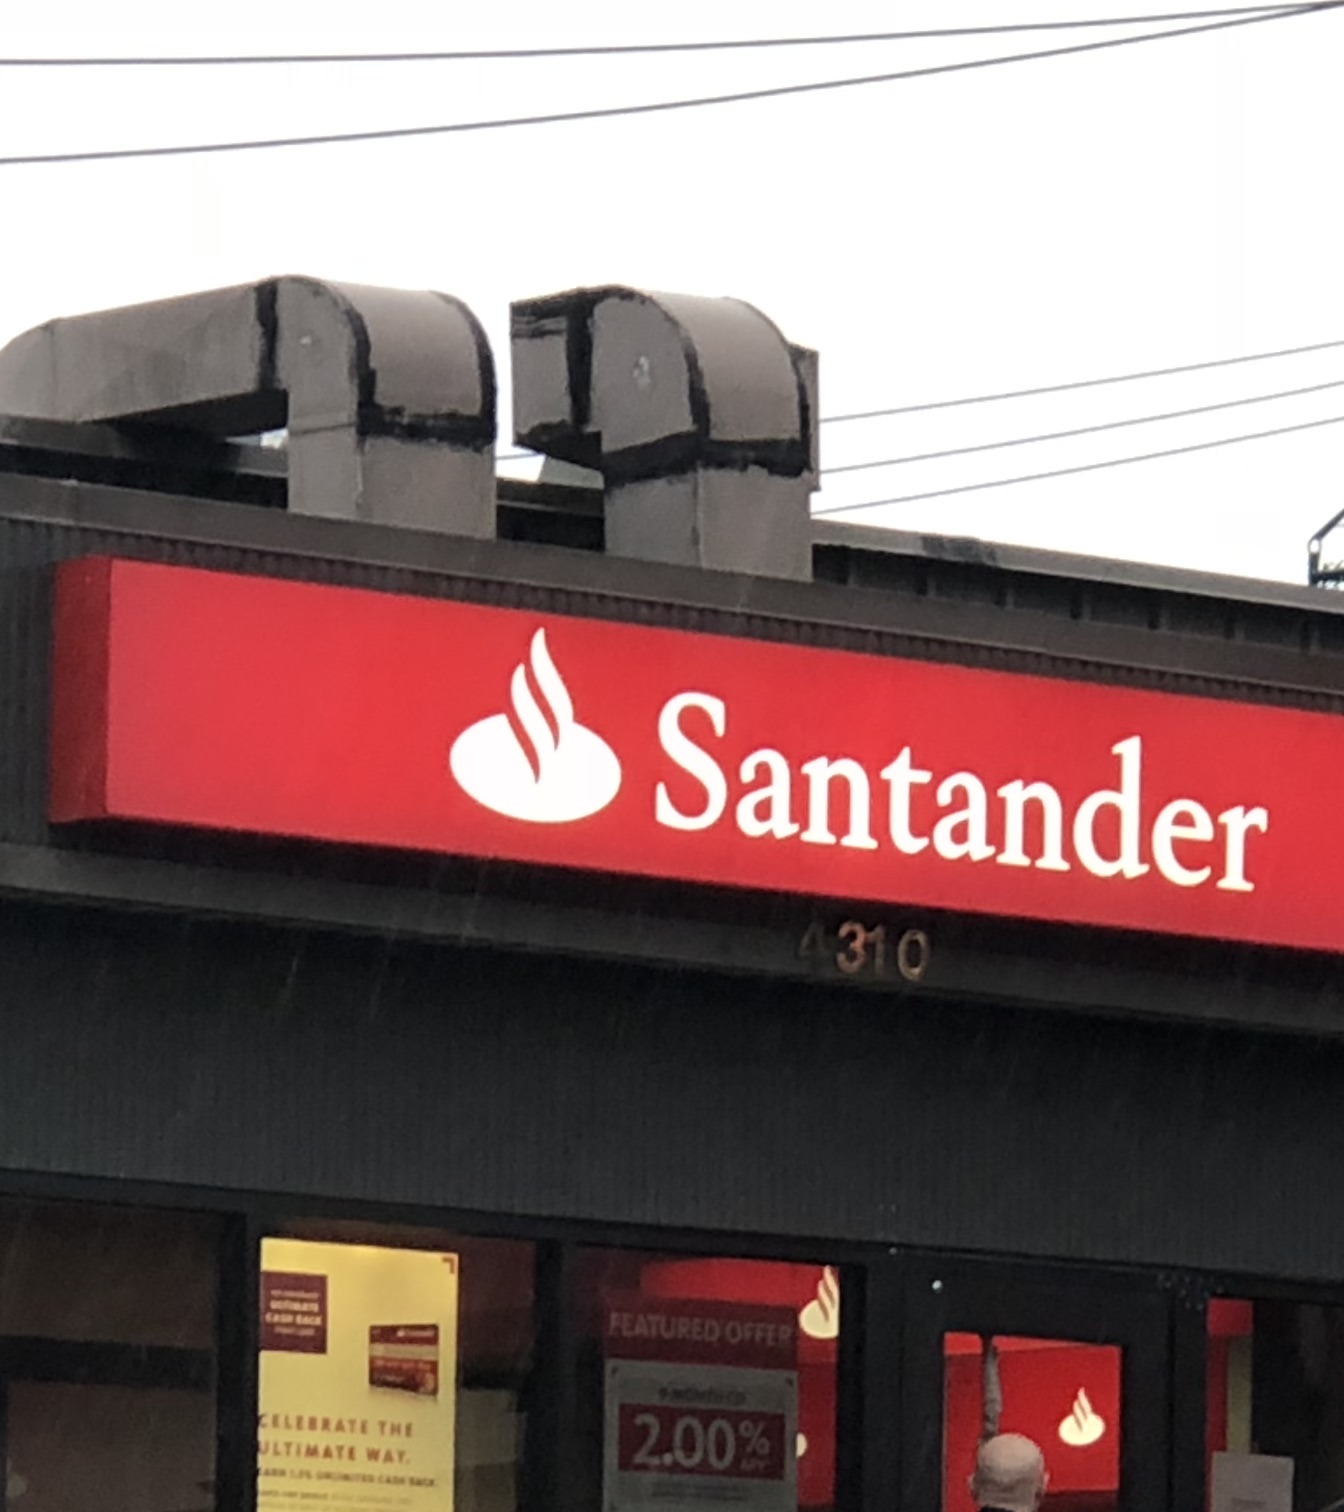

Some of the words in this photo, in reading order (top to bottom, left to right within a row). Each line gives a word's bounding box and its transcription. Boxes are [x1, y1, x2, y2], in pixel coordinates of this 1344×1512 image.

[656, 691, 1269, 892] Santander
[608, 1311, 720, 1343] FEATURED
[724, 1320, 793, 1347] OFFER
[257, 1412, 369, 1436] CELEBRATE
[377, 1419, 414, 1438] THE
[632, 1413, 770, 1471] 2.00%
[257, 1440, 357, 1462] ULTIMATE
